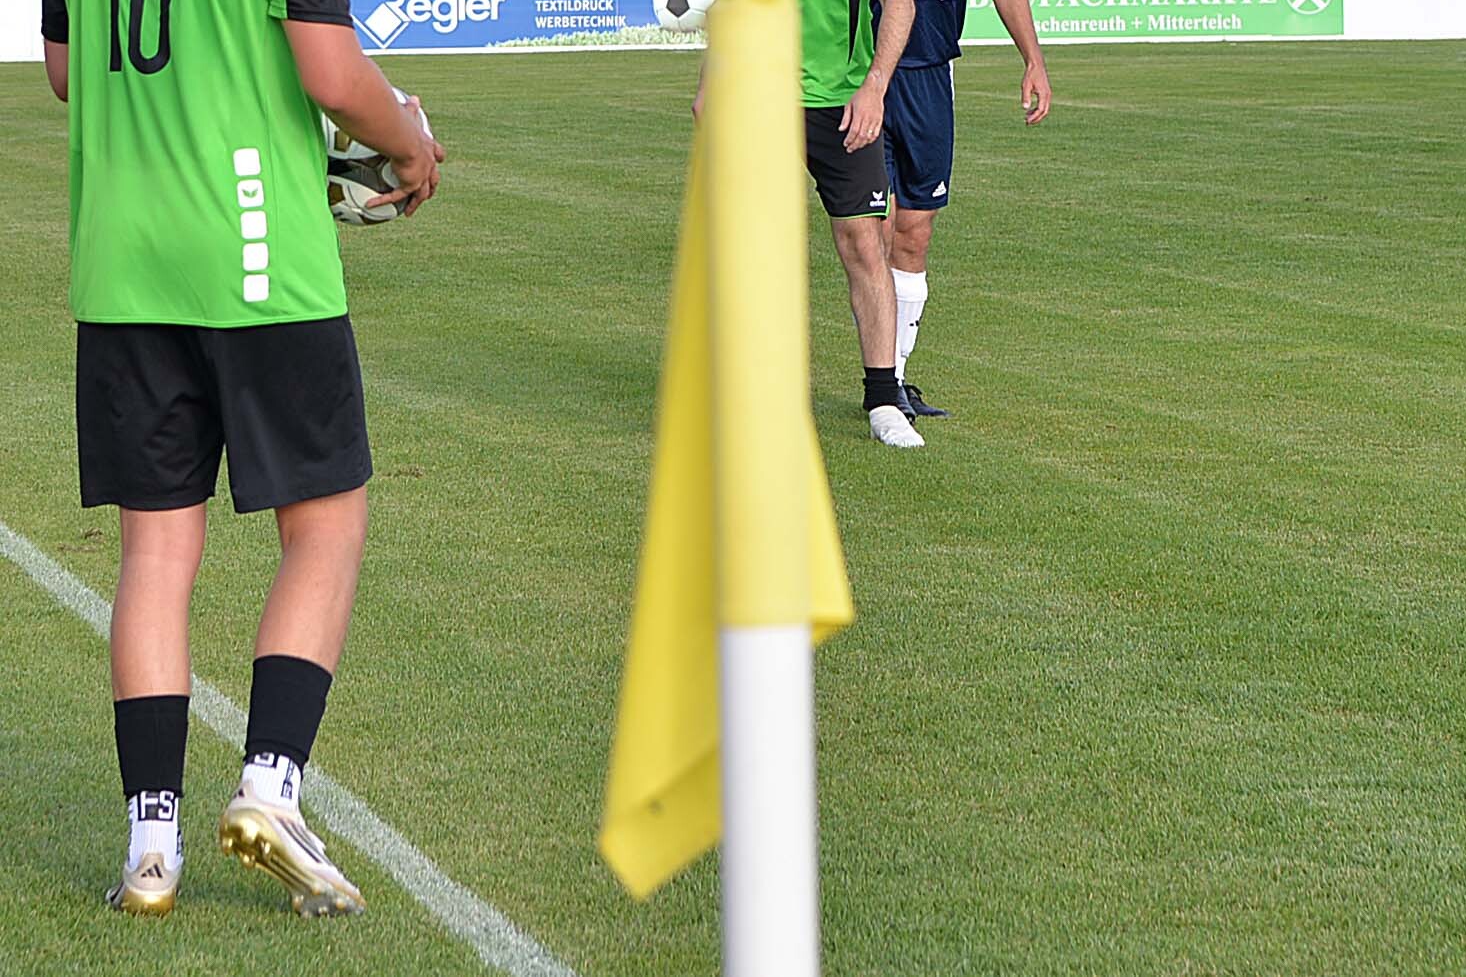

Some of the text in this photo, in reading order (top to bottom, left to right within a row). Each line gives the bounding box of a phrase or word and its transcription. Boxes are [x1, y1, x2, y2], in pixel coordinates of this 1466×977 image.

[535, 0, 614, 12] TEXTILDRUCK
[535, 15, 626, 28] WERBETECHNIK
[1147, 13, 1243, 31] Mitterteich
